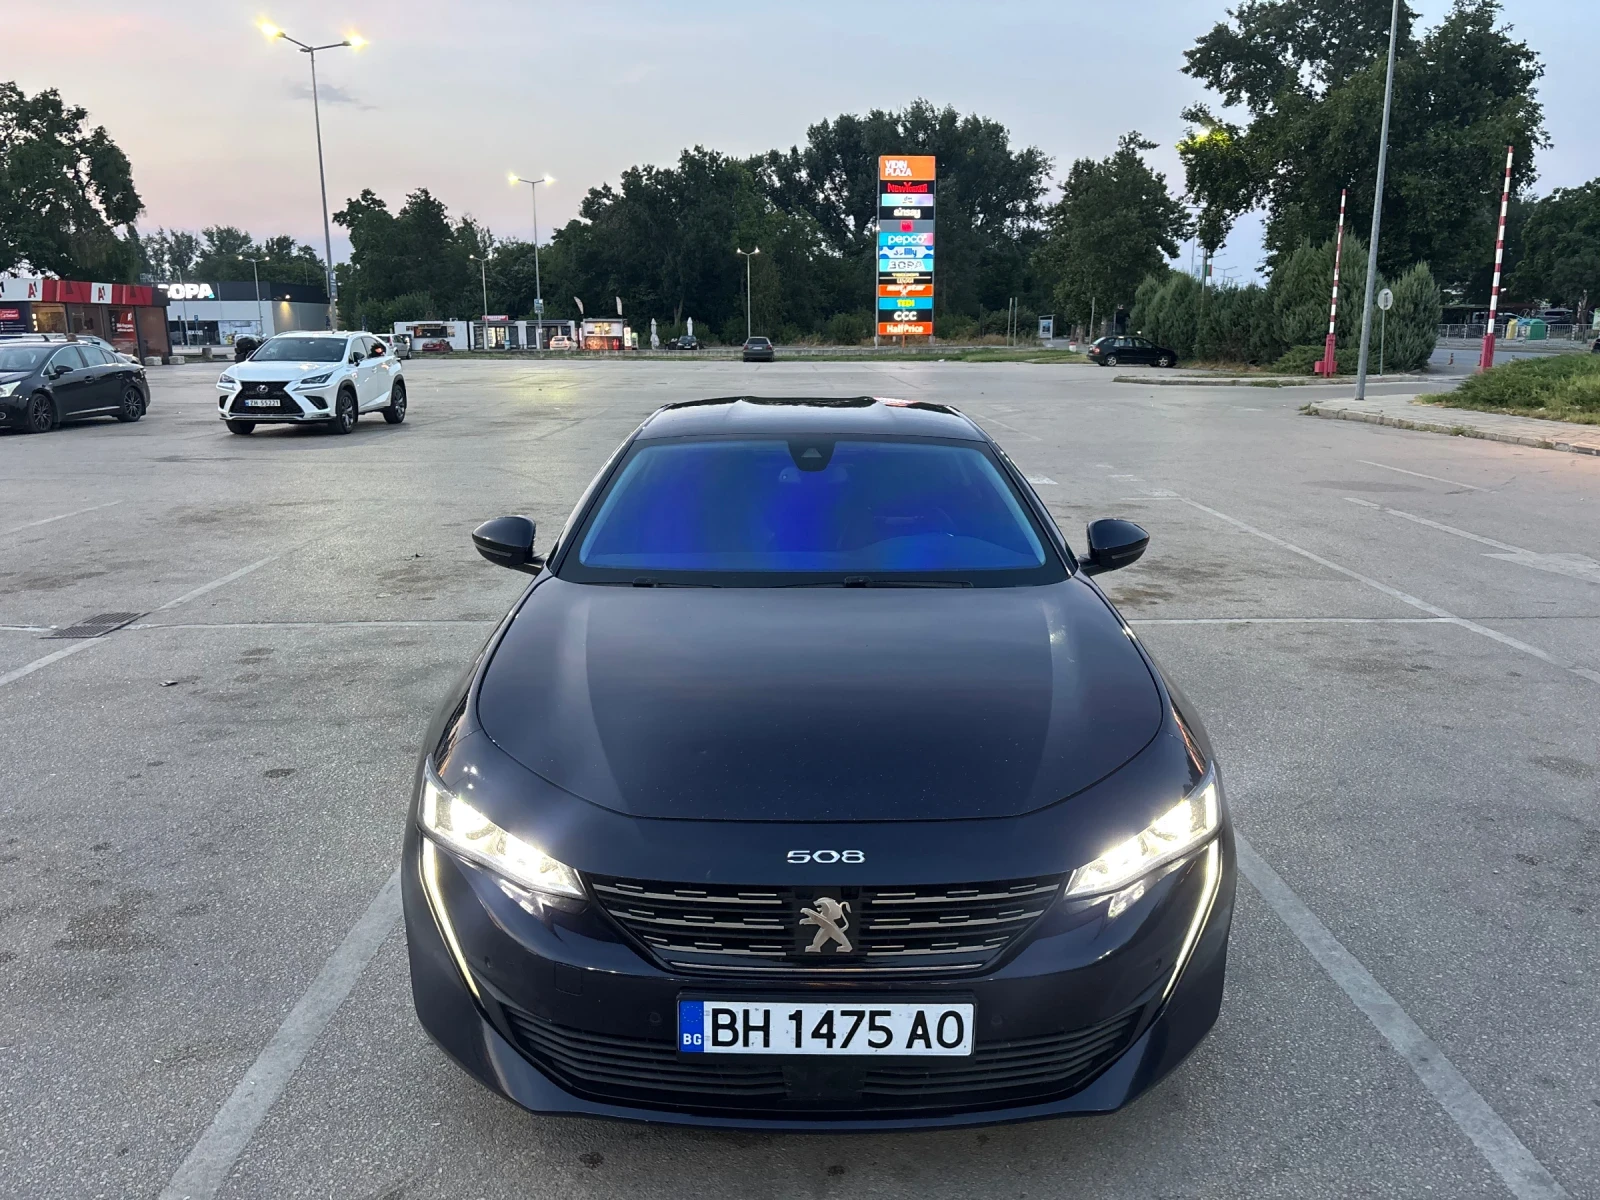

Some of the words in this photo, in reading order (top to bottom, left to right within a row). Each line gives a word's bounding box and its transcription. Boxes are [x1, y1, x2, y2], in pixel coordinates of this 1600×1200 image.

[885, 168, 912, 176] PLAZA
[887, 234, 925, 245] pepco
[28, 281, 38, 298] A1
[98, 286, 106, 301] A1
[893, 311, 917, 320] CCC
[786, 850, 866, 863] 508
[711, 1008, 770, 1048] BH
[788, 1009, 894, 1049] 1475
[906, 1010, 964, 1049] AO
[683, 1033, 702, 1045] BG
